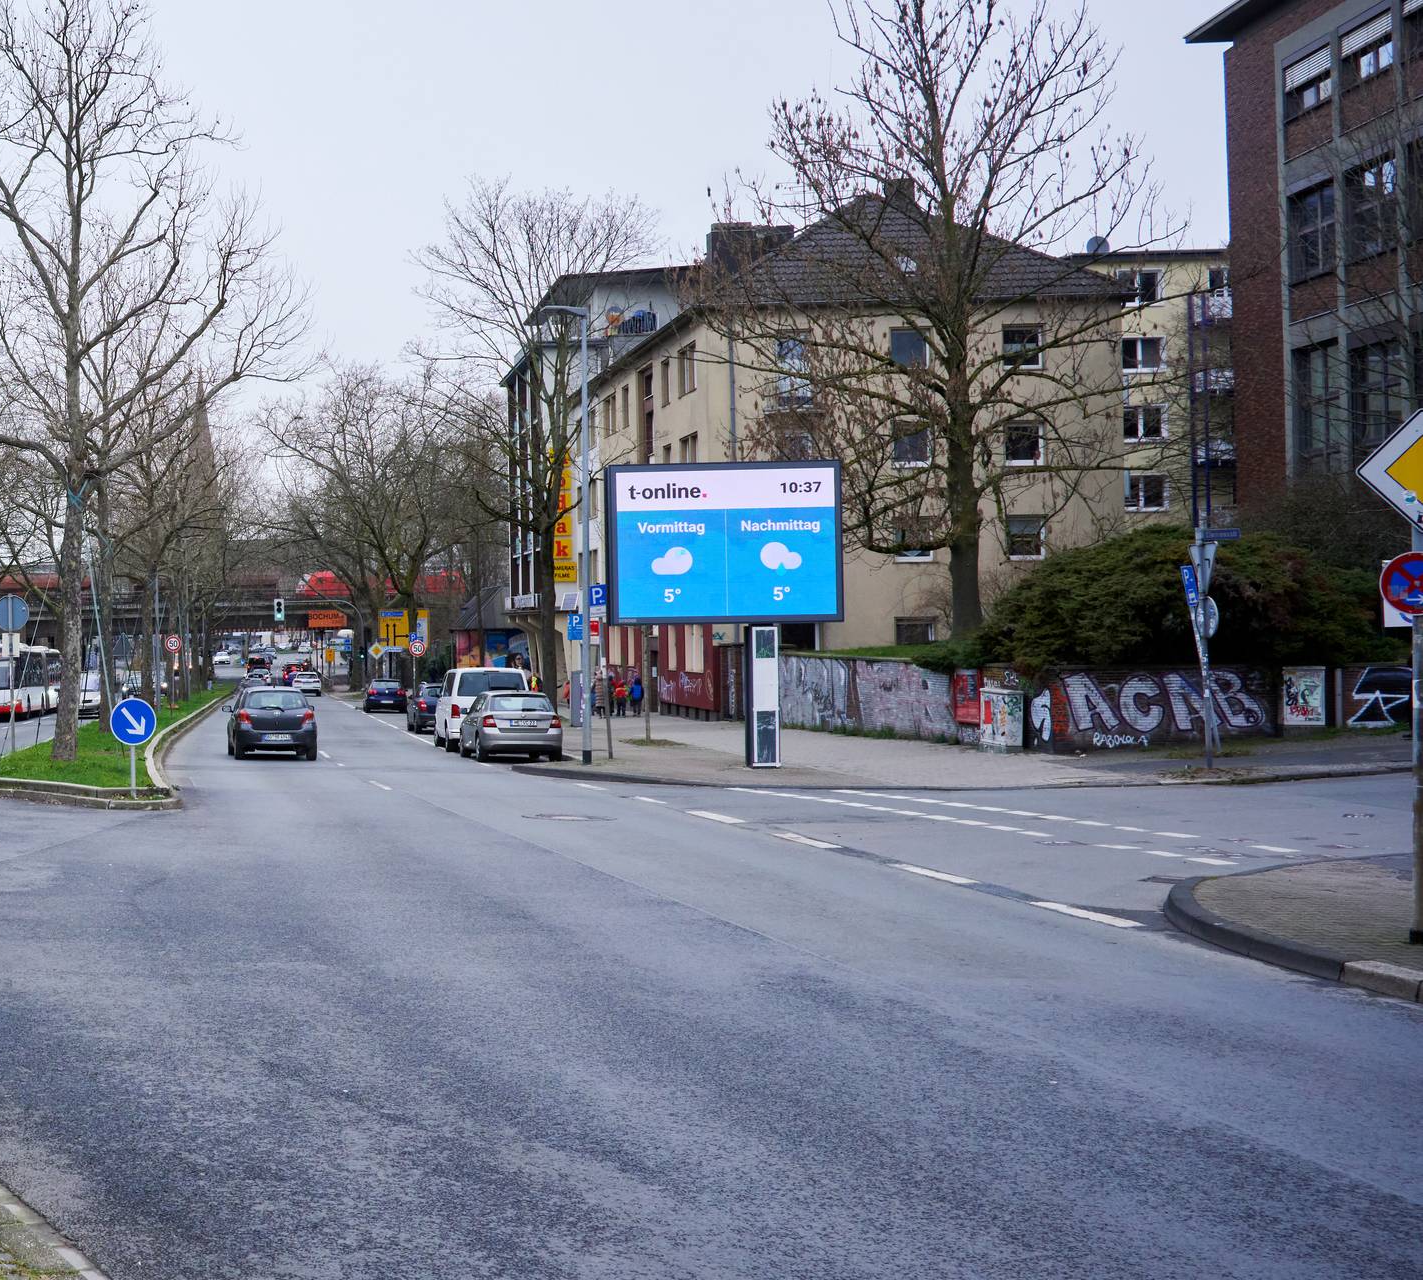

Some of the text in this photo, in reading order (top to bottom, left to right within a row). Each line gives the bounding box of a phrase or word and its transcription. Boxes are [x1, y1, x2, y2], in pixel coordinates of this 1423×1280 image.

[628, 483, 707, 500] t-online.
[780, 481, 822, 494] 10:37
[637, 520, 706, 536] Vormittag
[740, 519, 821, 534] Nachmittag
[591, 588, 604, 605] P
[664, 588, 681, 603] 5°
[772, 586, 790, 601] 5°
[573, 616, 581, 628] P
[168, 640, 178, 648] 50
[1061, 671, 1266, 733] ACAB
